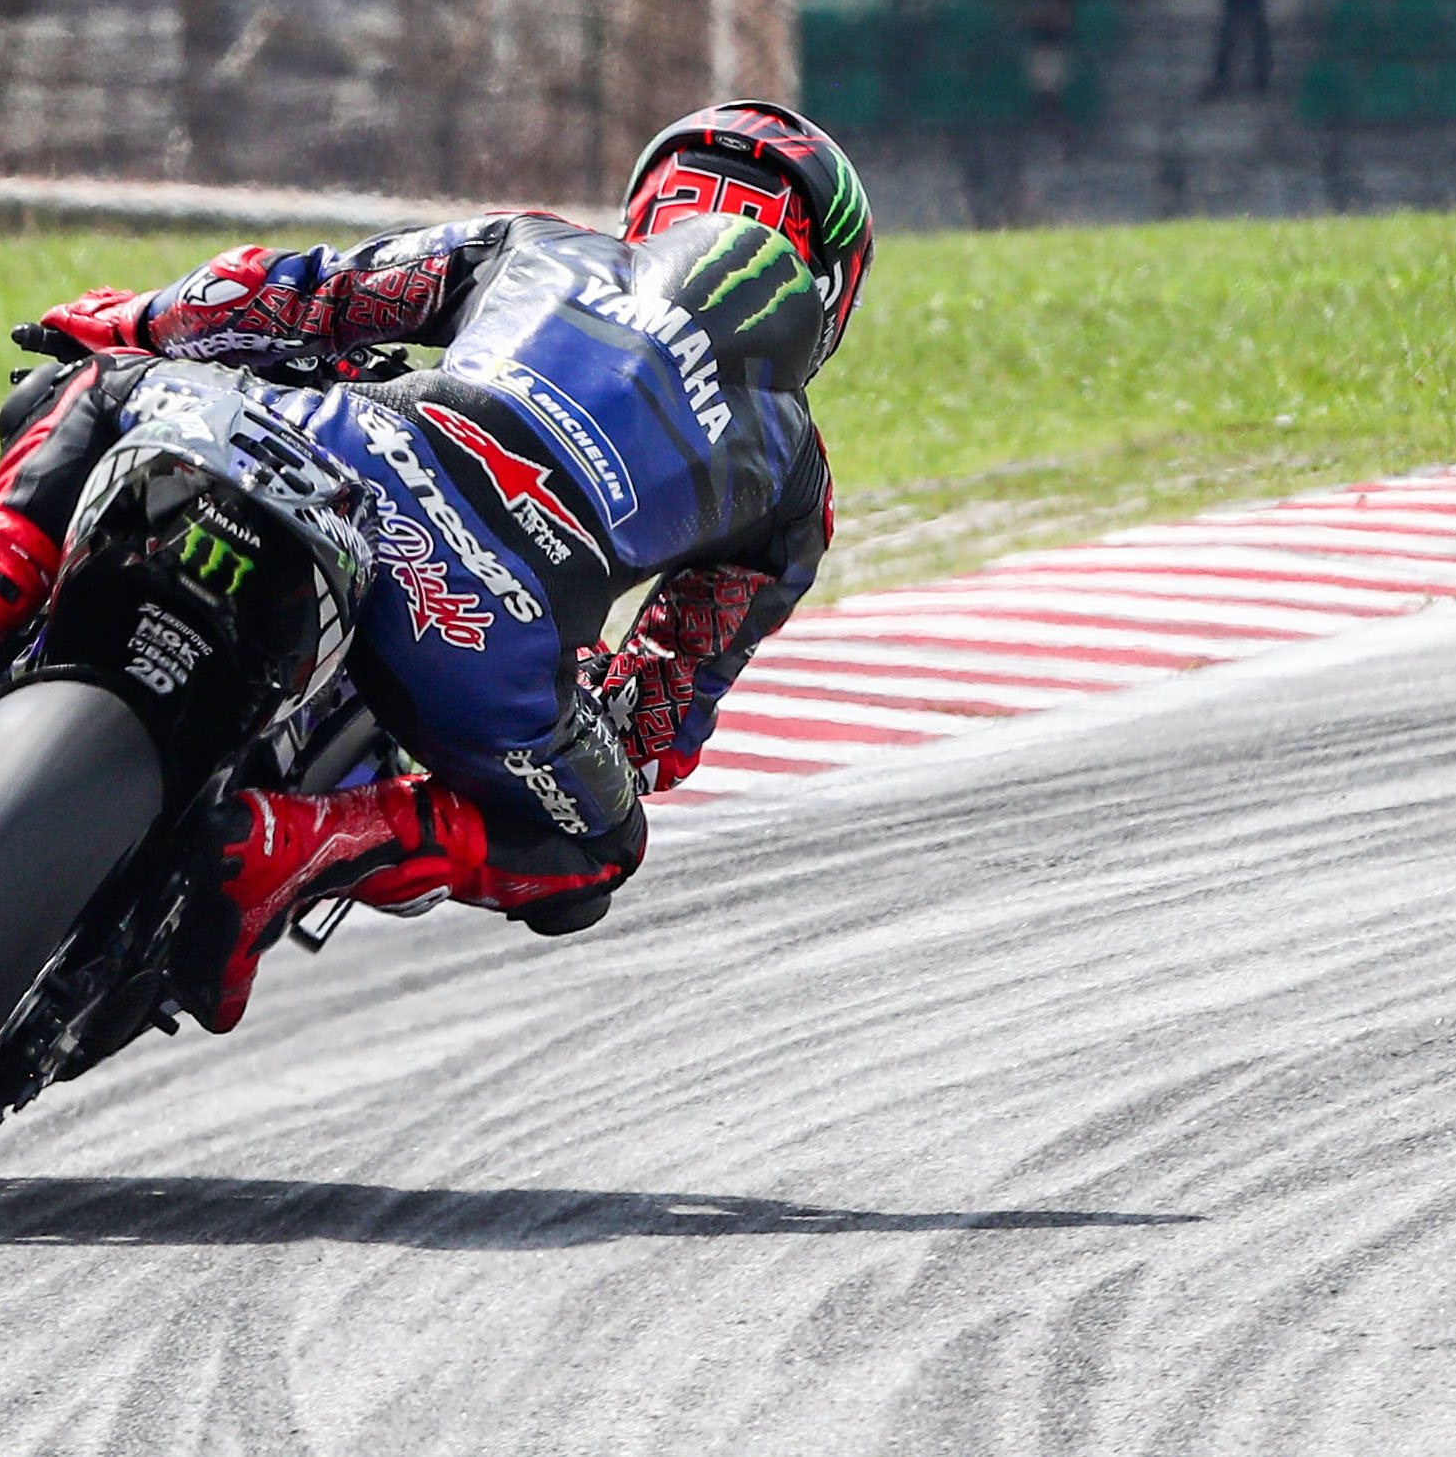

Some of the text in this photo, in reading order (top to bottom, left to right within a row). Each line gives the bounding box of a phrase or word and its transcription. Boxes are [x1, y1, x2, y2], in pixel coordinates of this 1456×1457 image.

[577, 276, 733, 444] YAMAHA
[357, 409, 543, 623] alpinestars
[532, 393, 625, 501] MICHELIN
[198, 497, 261, 549] YAMAHA
